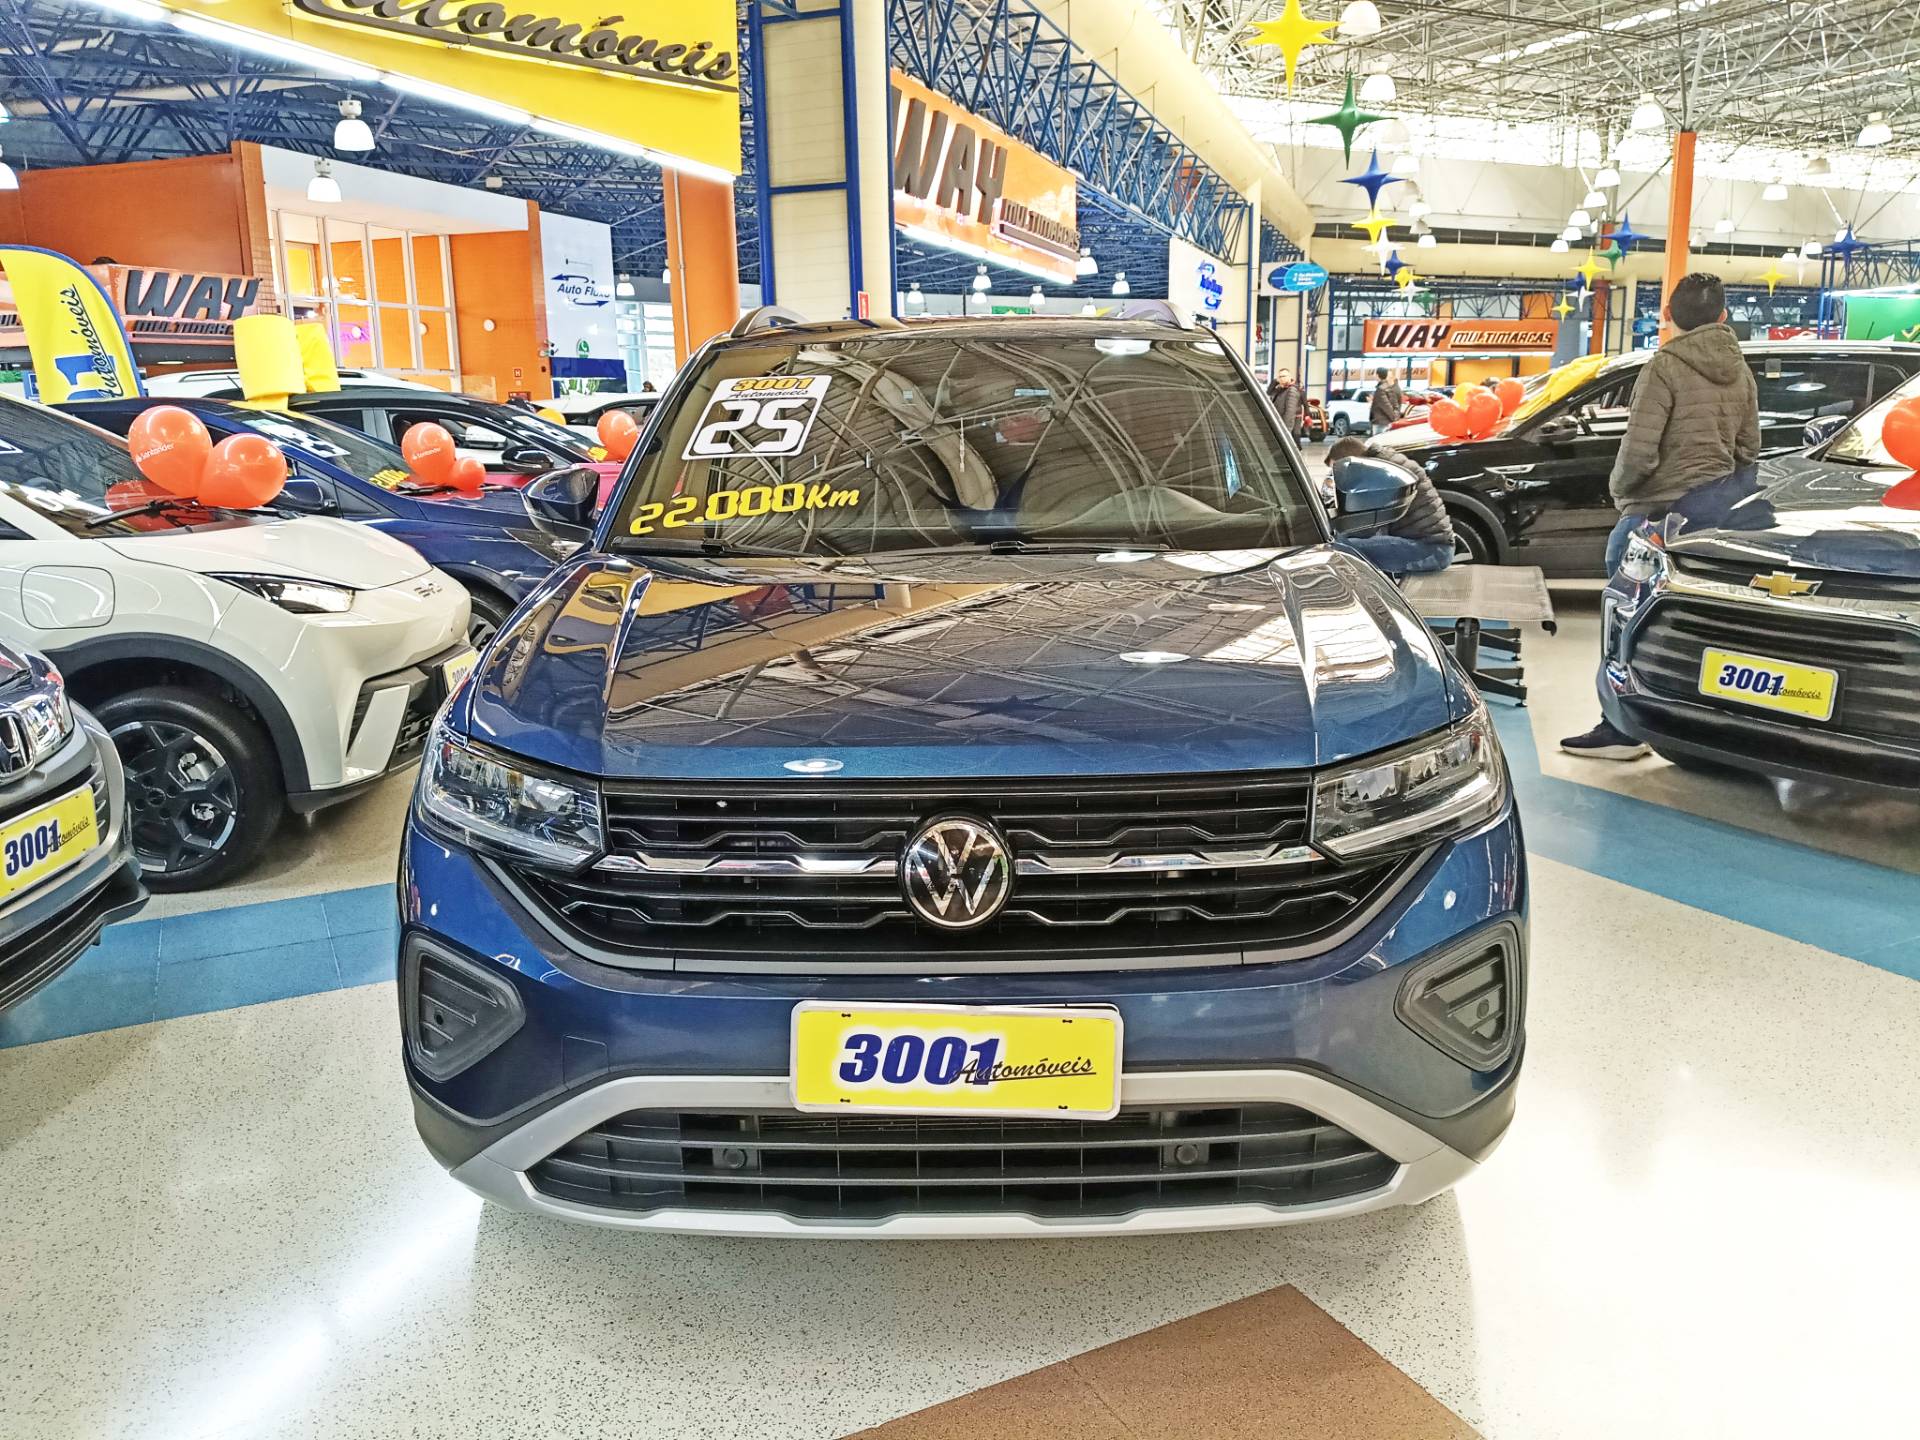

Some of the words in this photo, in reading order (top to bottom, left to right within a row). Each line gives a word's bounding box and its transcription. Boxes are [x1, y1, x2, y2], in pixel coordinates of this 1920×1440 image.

[889, 84, 1008, 226] WAY
[126, 270, 259, 320] WAY
[557, 283, 582, 295] Auto
[585, 286, 610, 298] Flu
[1376, 324, 1452, 348] WAY
[1450, 330, 1553, 345] MULTIMARCAS
[731, 377, 816, 392] 3001
[693, 400, 808, 455] 25
[1718, 664, 1785, 697] 3001
[4, 819, 60, 877] 3001
[838, 1033, 1000, 1086] 3001
[950, 1056, 1097, 1085] Automóveis
